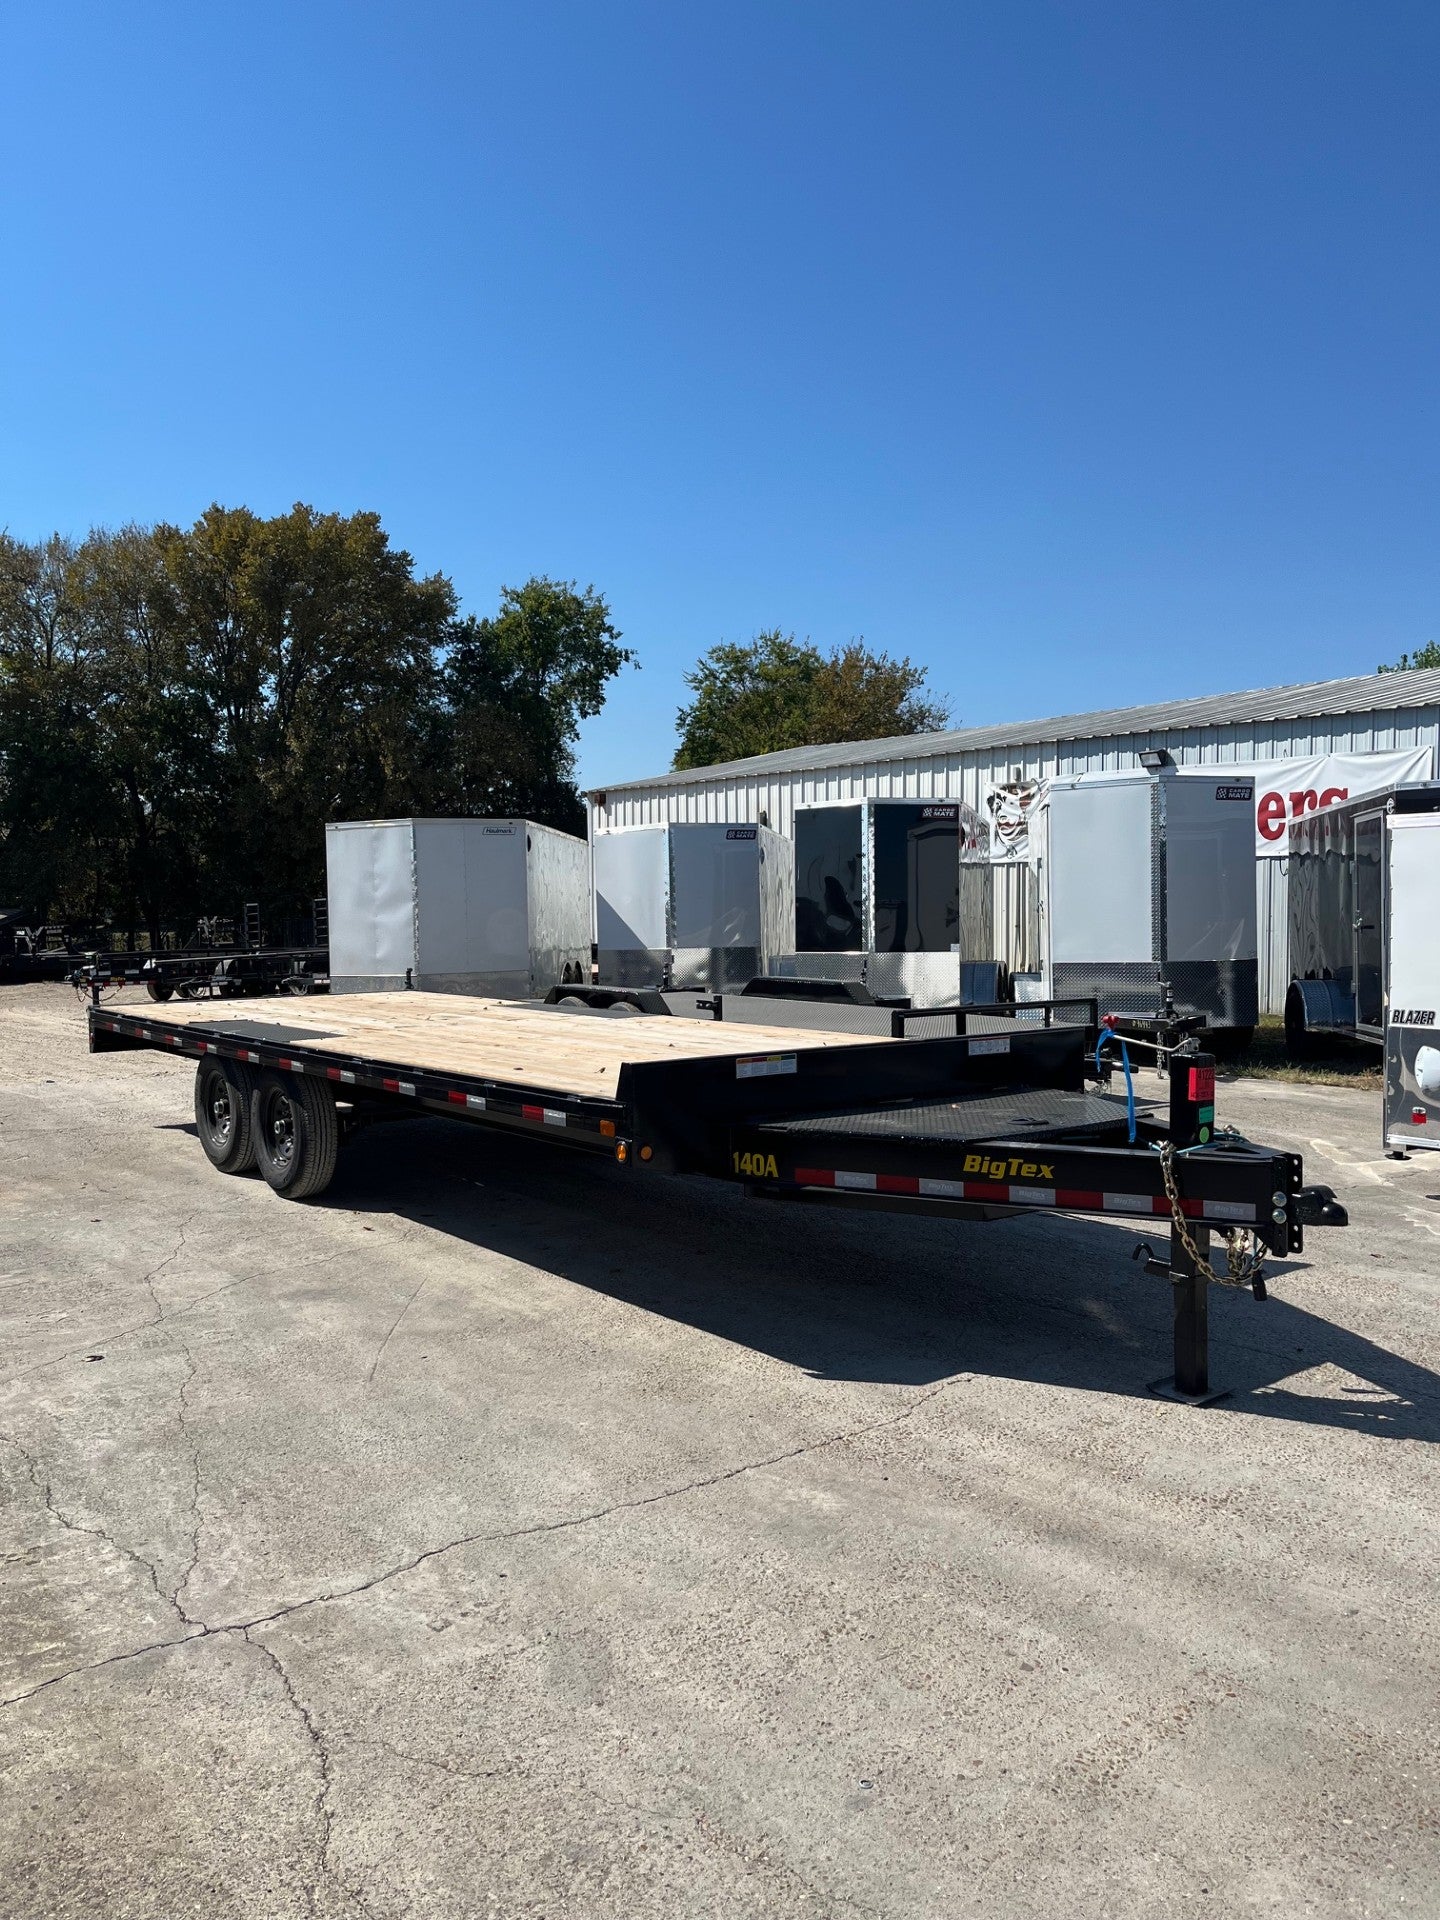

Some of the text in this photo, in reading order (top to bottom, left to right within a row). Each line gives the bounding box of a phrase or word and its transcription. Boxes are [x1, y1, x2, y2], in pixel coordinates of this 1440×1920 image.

[1391, 1009, 1436, 1026] BLAZER
[733, 1152, 779, 1178] 140A
[963, 1154, 1056, 1180] BigTex
